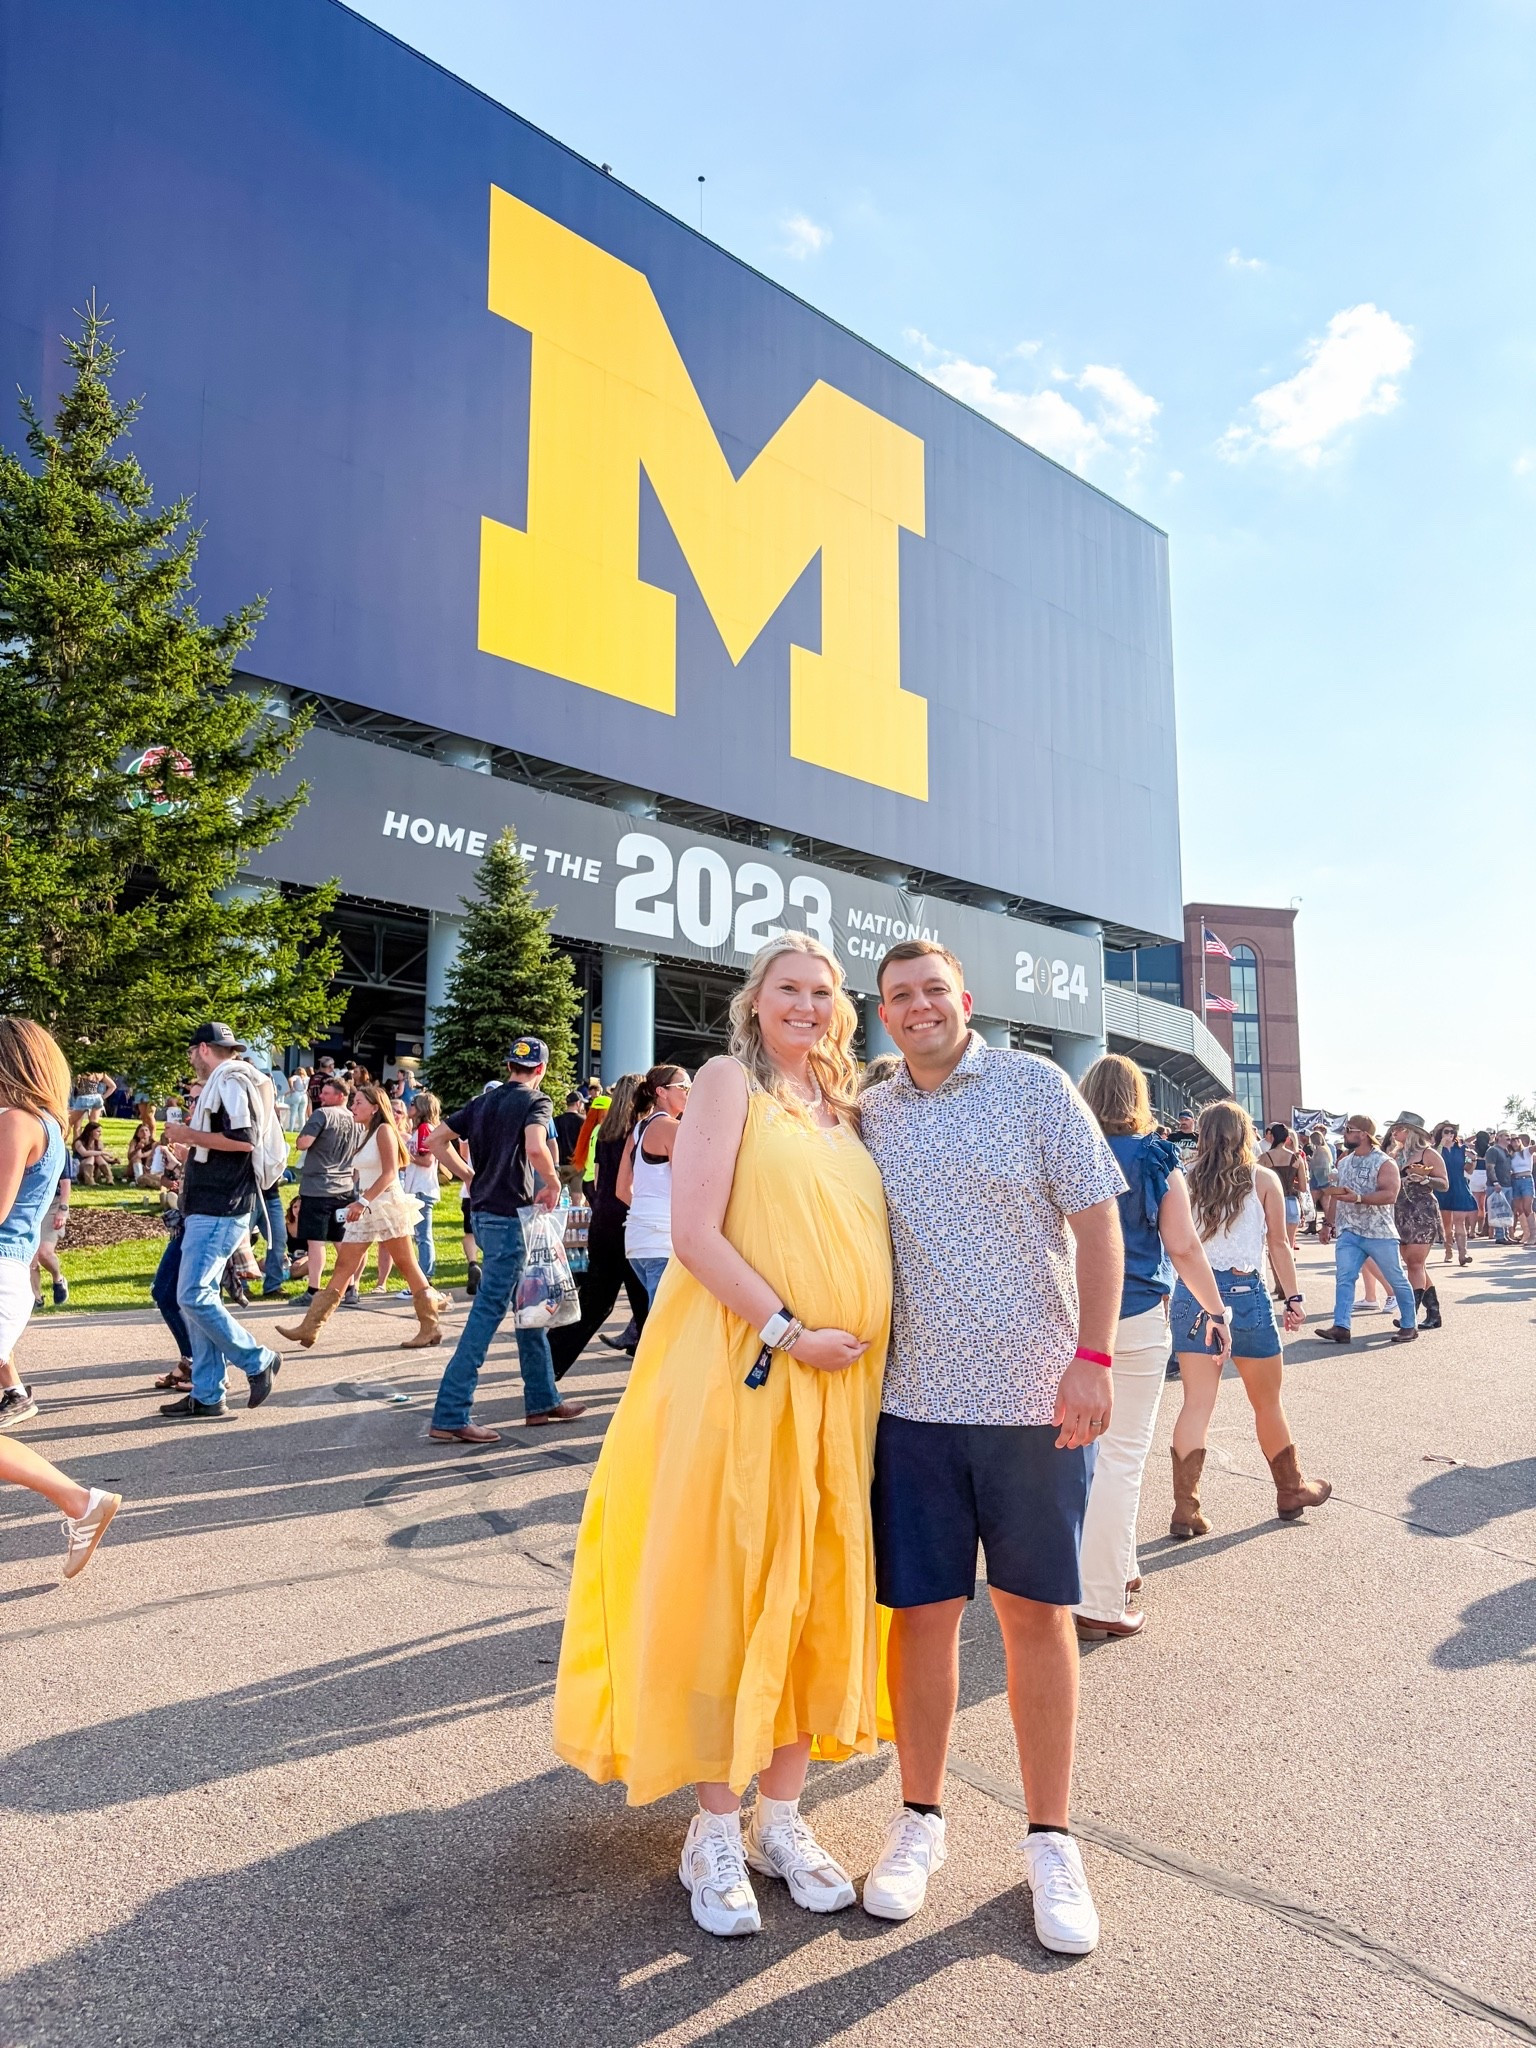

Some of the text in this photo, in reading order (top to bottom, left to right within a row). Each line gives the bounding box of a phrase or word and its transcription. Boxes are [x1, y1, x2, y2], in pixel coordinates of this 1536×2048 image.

[478, 182, 928, 803] M
[382, 810, 488, 858] HOME
[544, 848, 602, 884] THE
[614, 832, 834, 955] 2023
